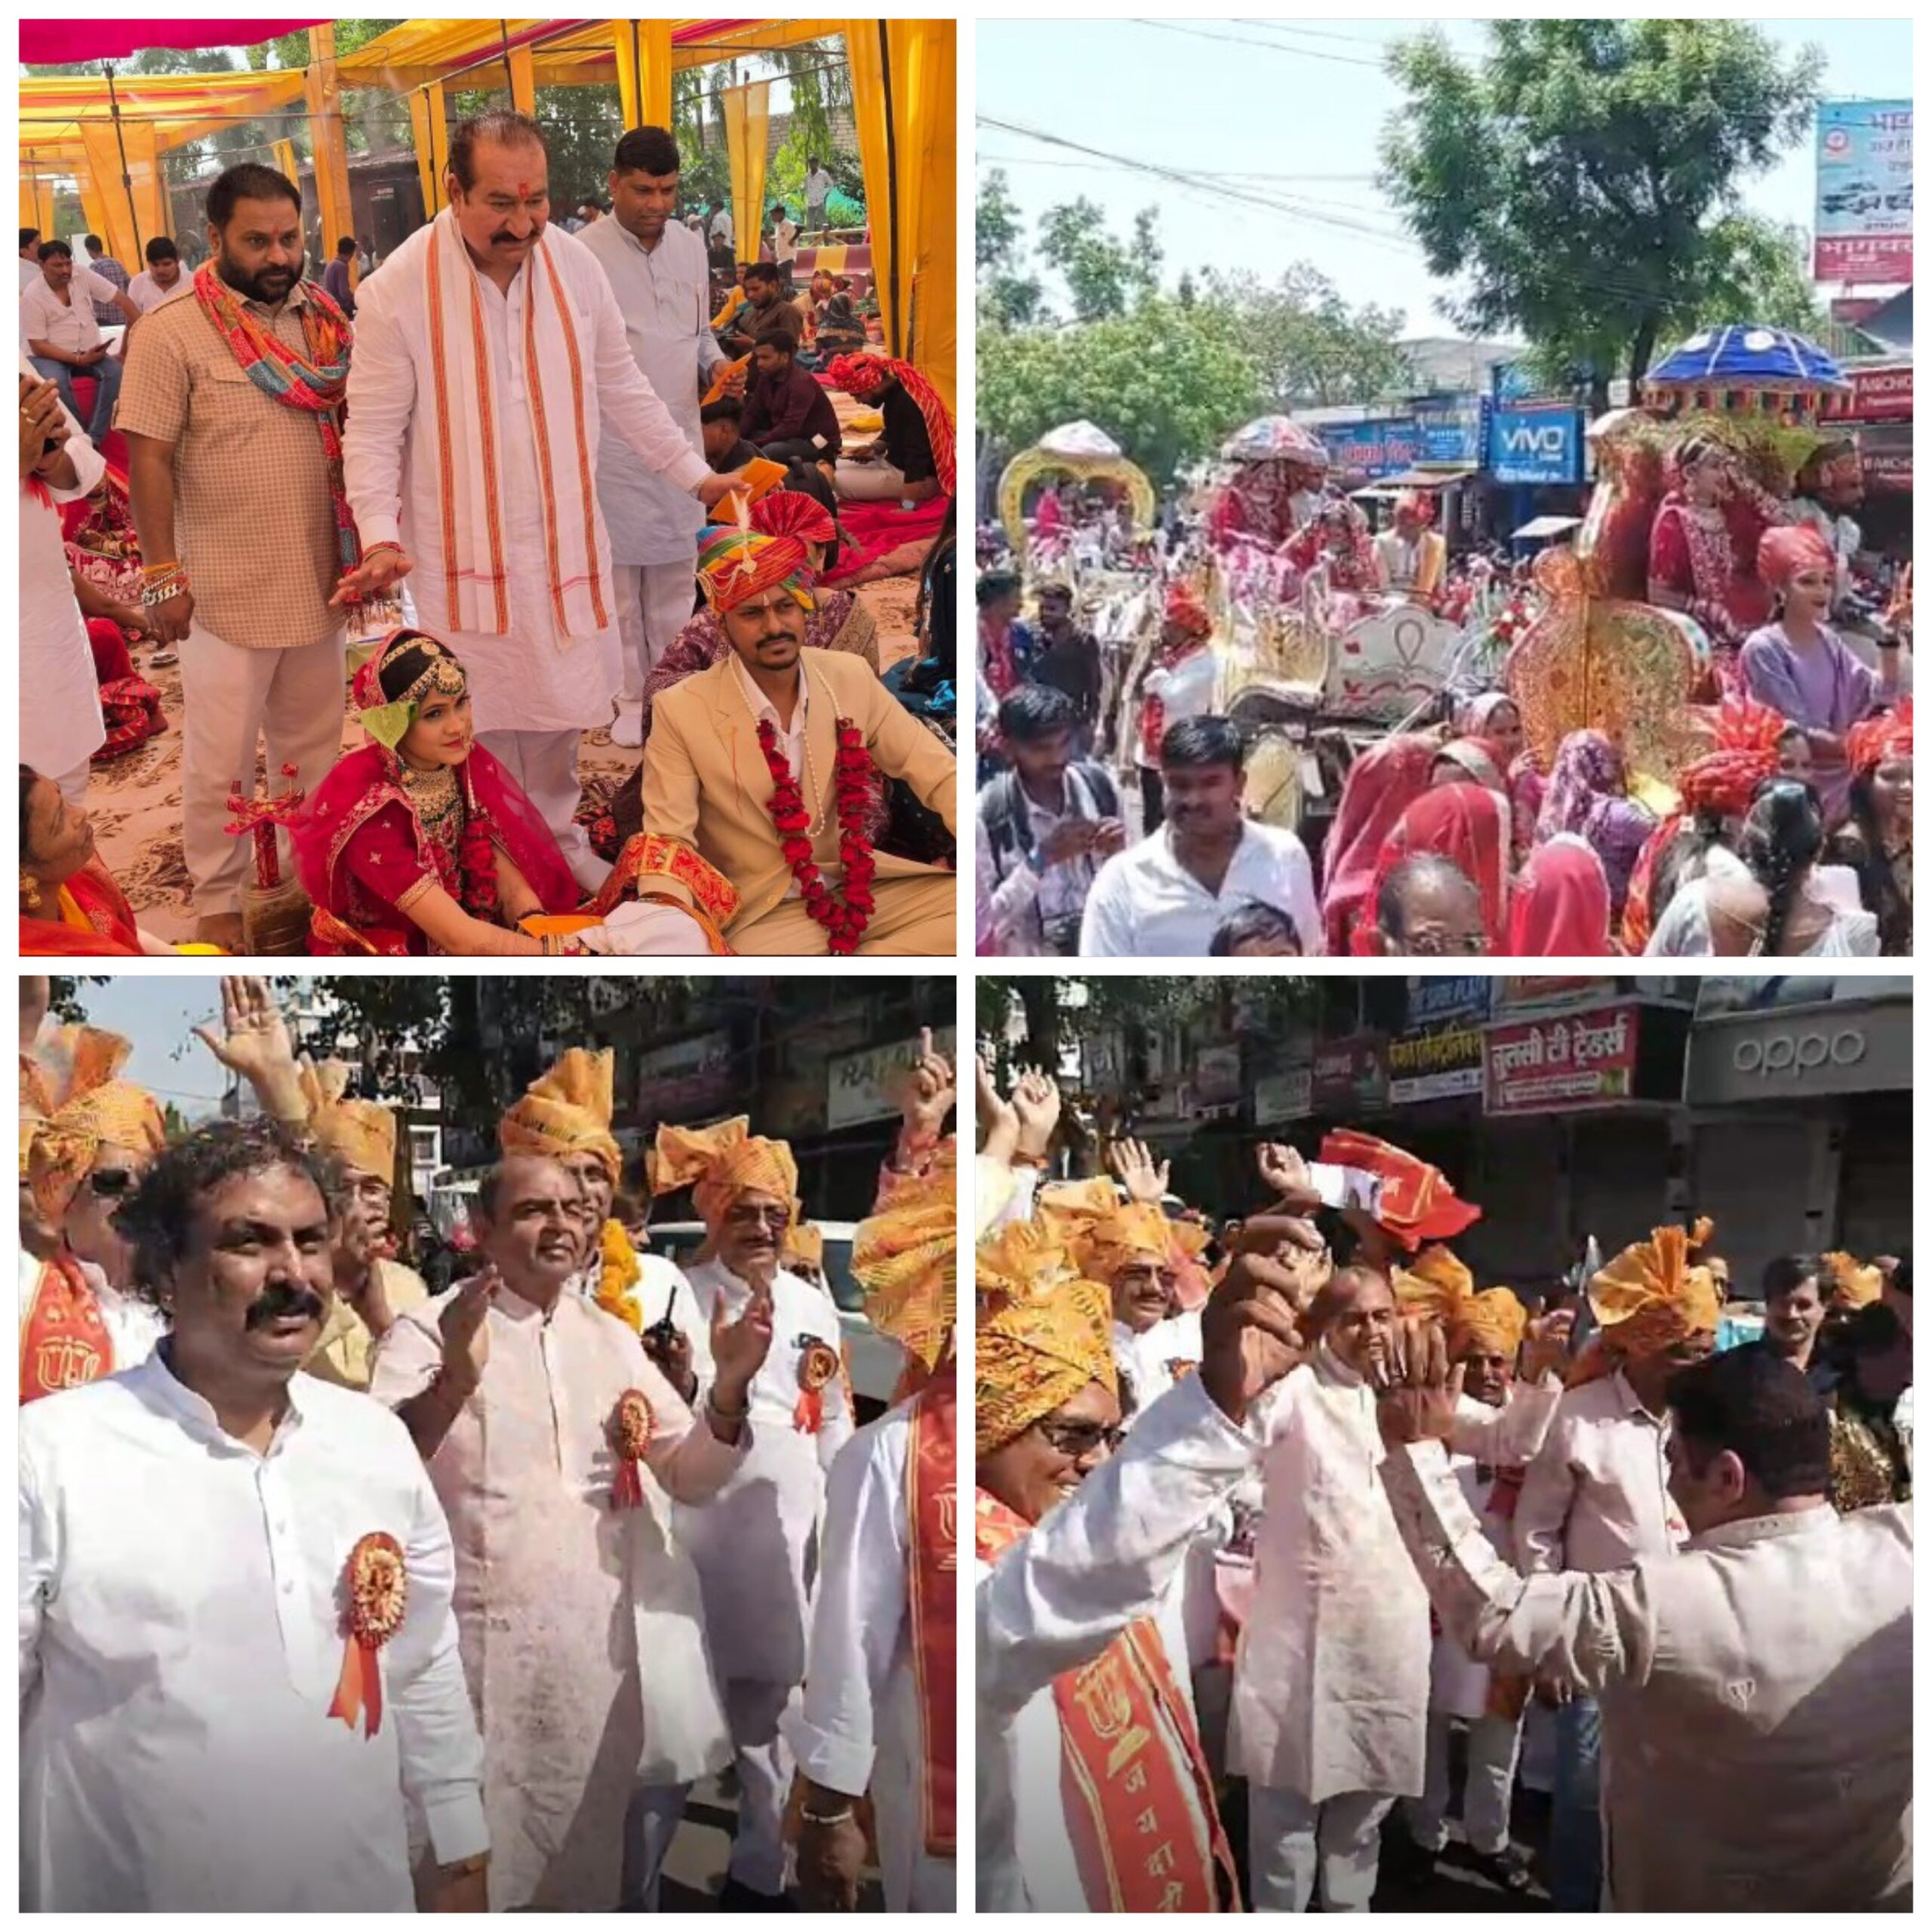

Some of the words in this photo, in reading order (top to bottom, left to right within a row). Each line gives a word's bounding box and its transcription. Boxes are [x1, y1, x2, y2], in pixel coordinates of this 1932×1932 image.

[1491, 1027, 1544, 1081] तुलसी
[1546, 1023, 1571, 1063] टी
[1573, 1013, 1629, 1069] ट्रेडर्स
